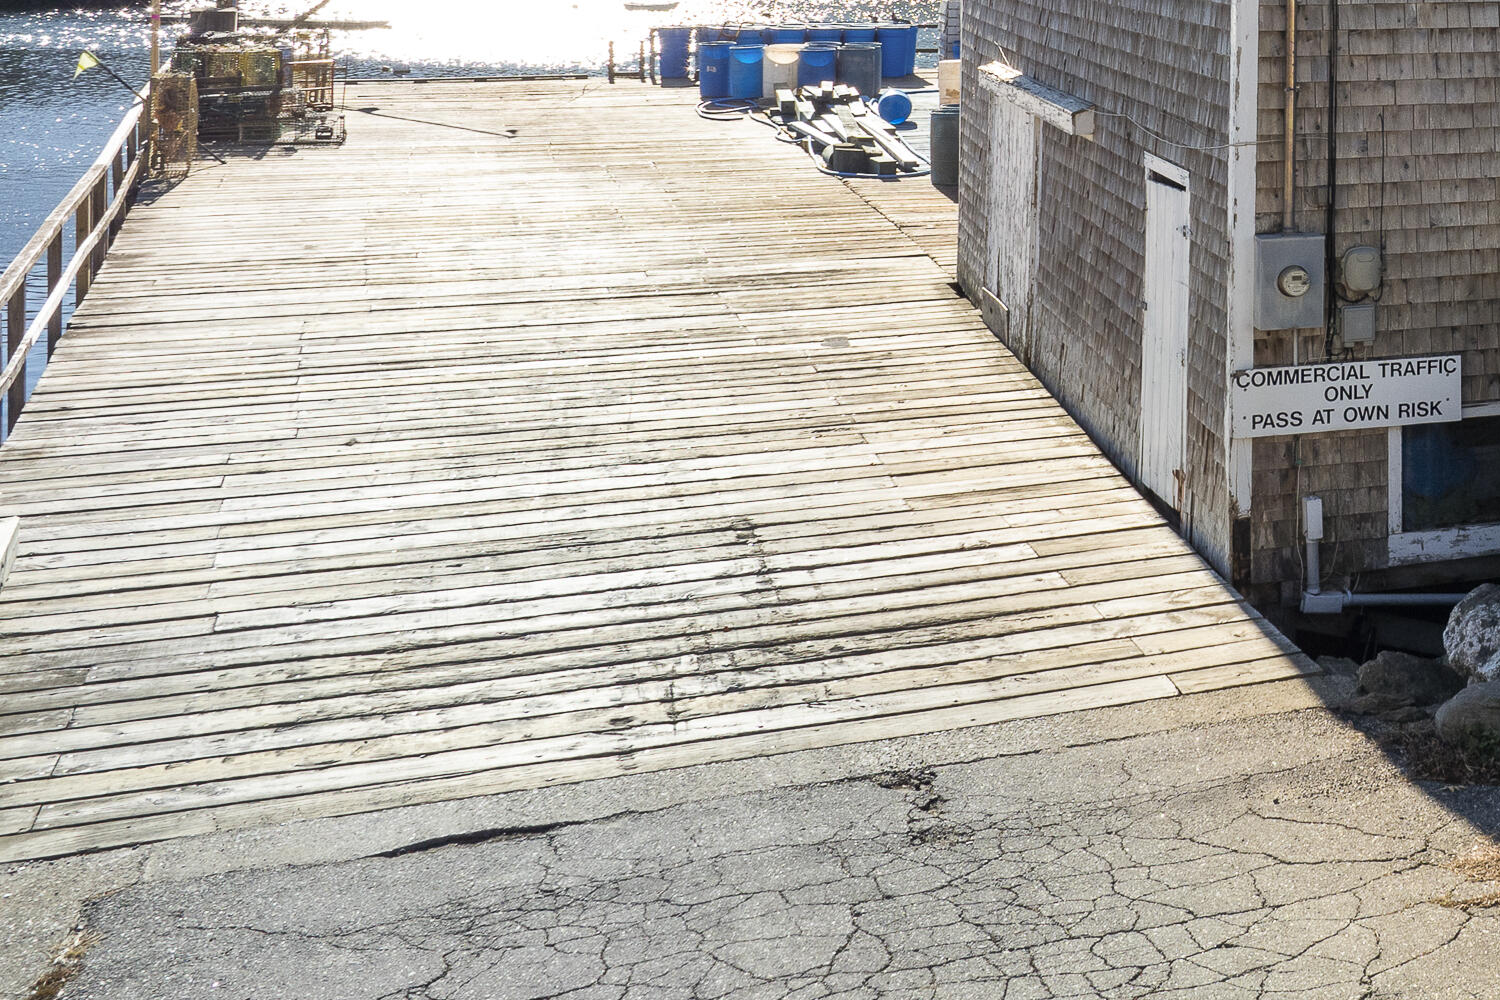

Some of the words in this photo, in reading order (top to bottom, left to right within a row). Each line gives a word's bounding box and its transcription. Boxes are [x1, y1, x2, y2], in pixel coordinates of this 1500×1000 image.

[1236, 364, 1370, 389] COMMERCIAL
[1378, 358, 1457, 378] TRAFFIC
[1324, 383, 1373, 402] ONLY
[1251, 411, 1303, 430] PASS
[1312, 408, 1335, 426] AT
[1343, 404, 1389, 423] OWN
[1398, 400, 1442, 419] RISK
